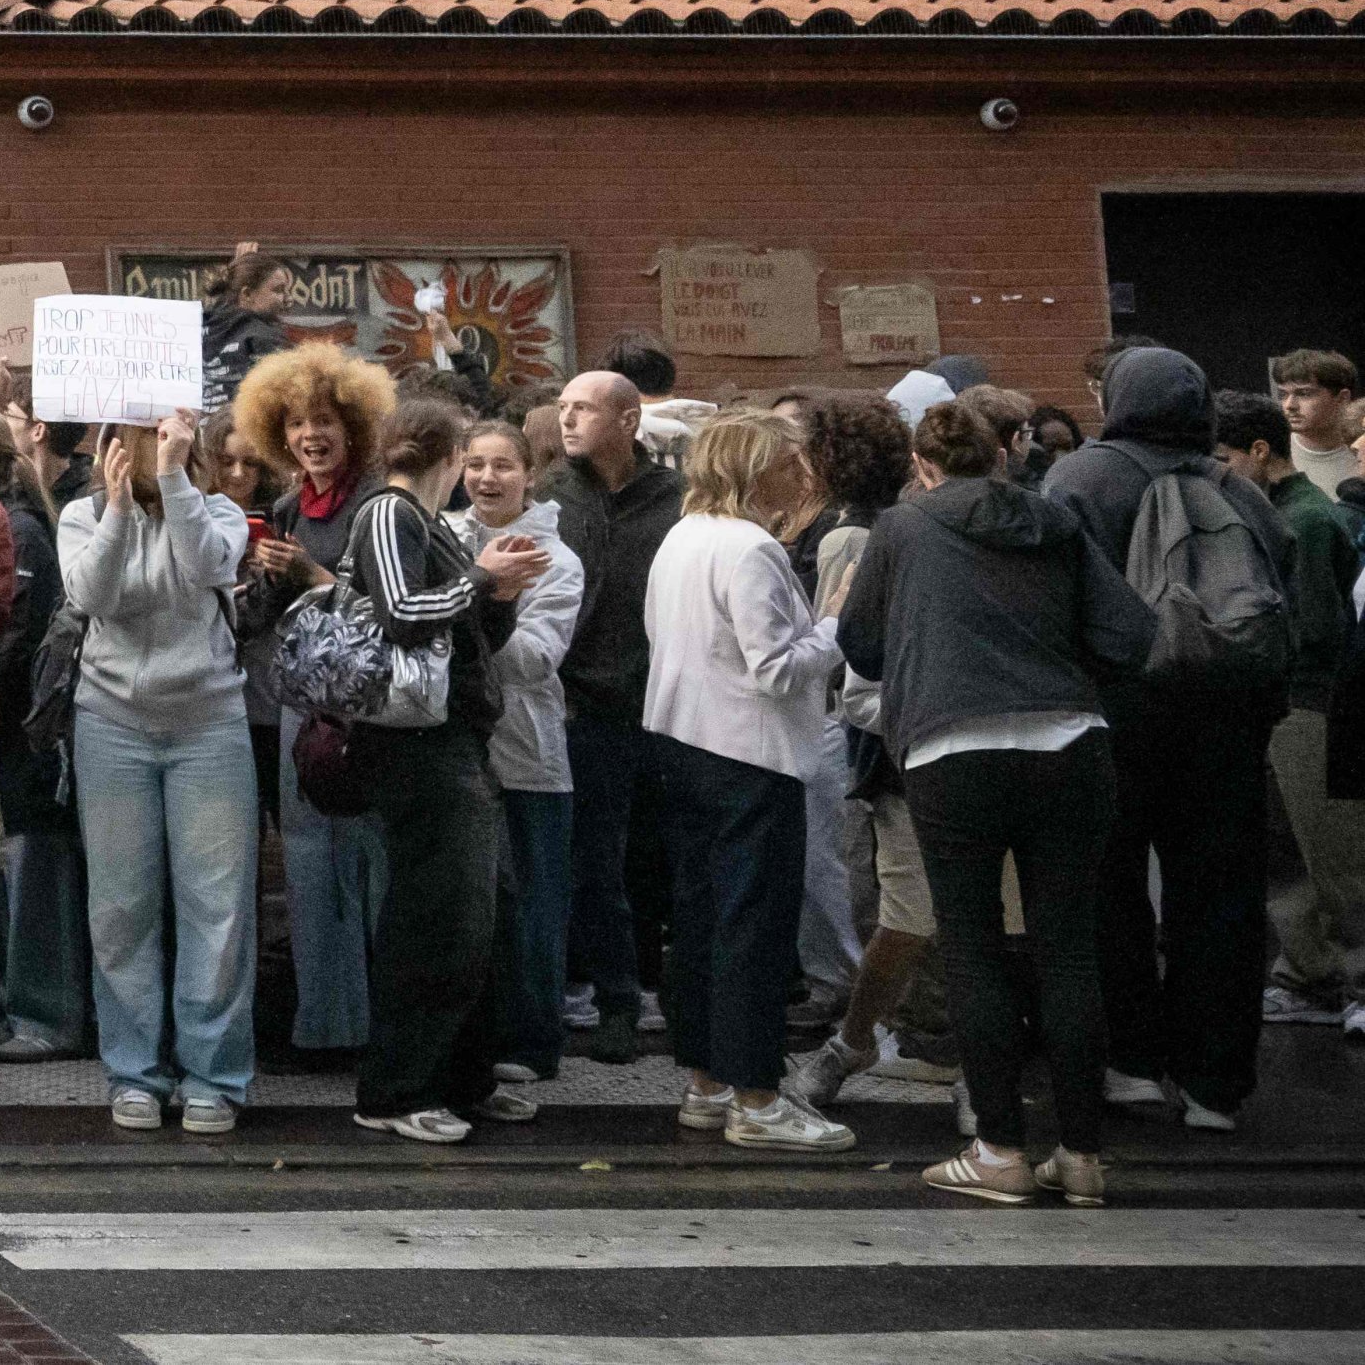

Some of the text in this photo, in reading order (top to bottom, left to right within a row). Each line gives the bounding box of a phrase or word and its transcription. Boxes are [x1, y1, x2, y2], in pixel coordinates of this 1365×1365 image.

[41, 307, 179, 340] TROP JEUNES
[37, 335, 82, 356] POUR
[115, 358, 158, 381] POUR
